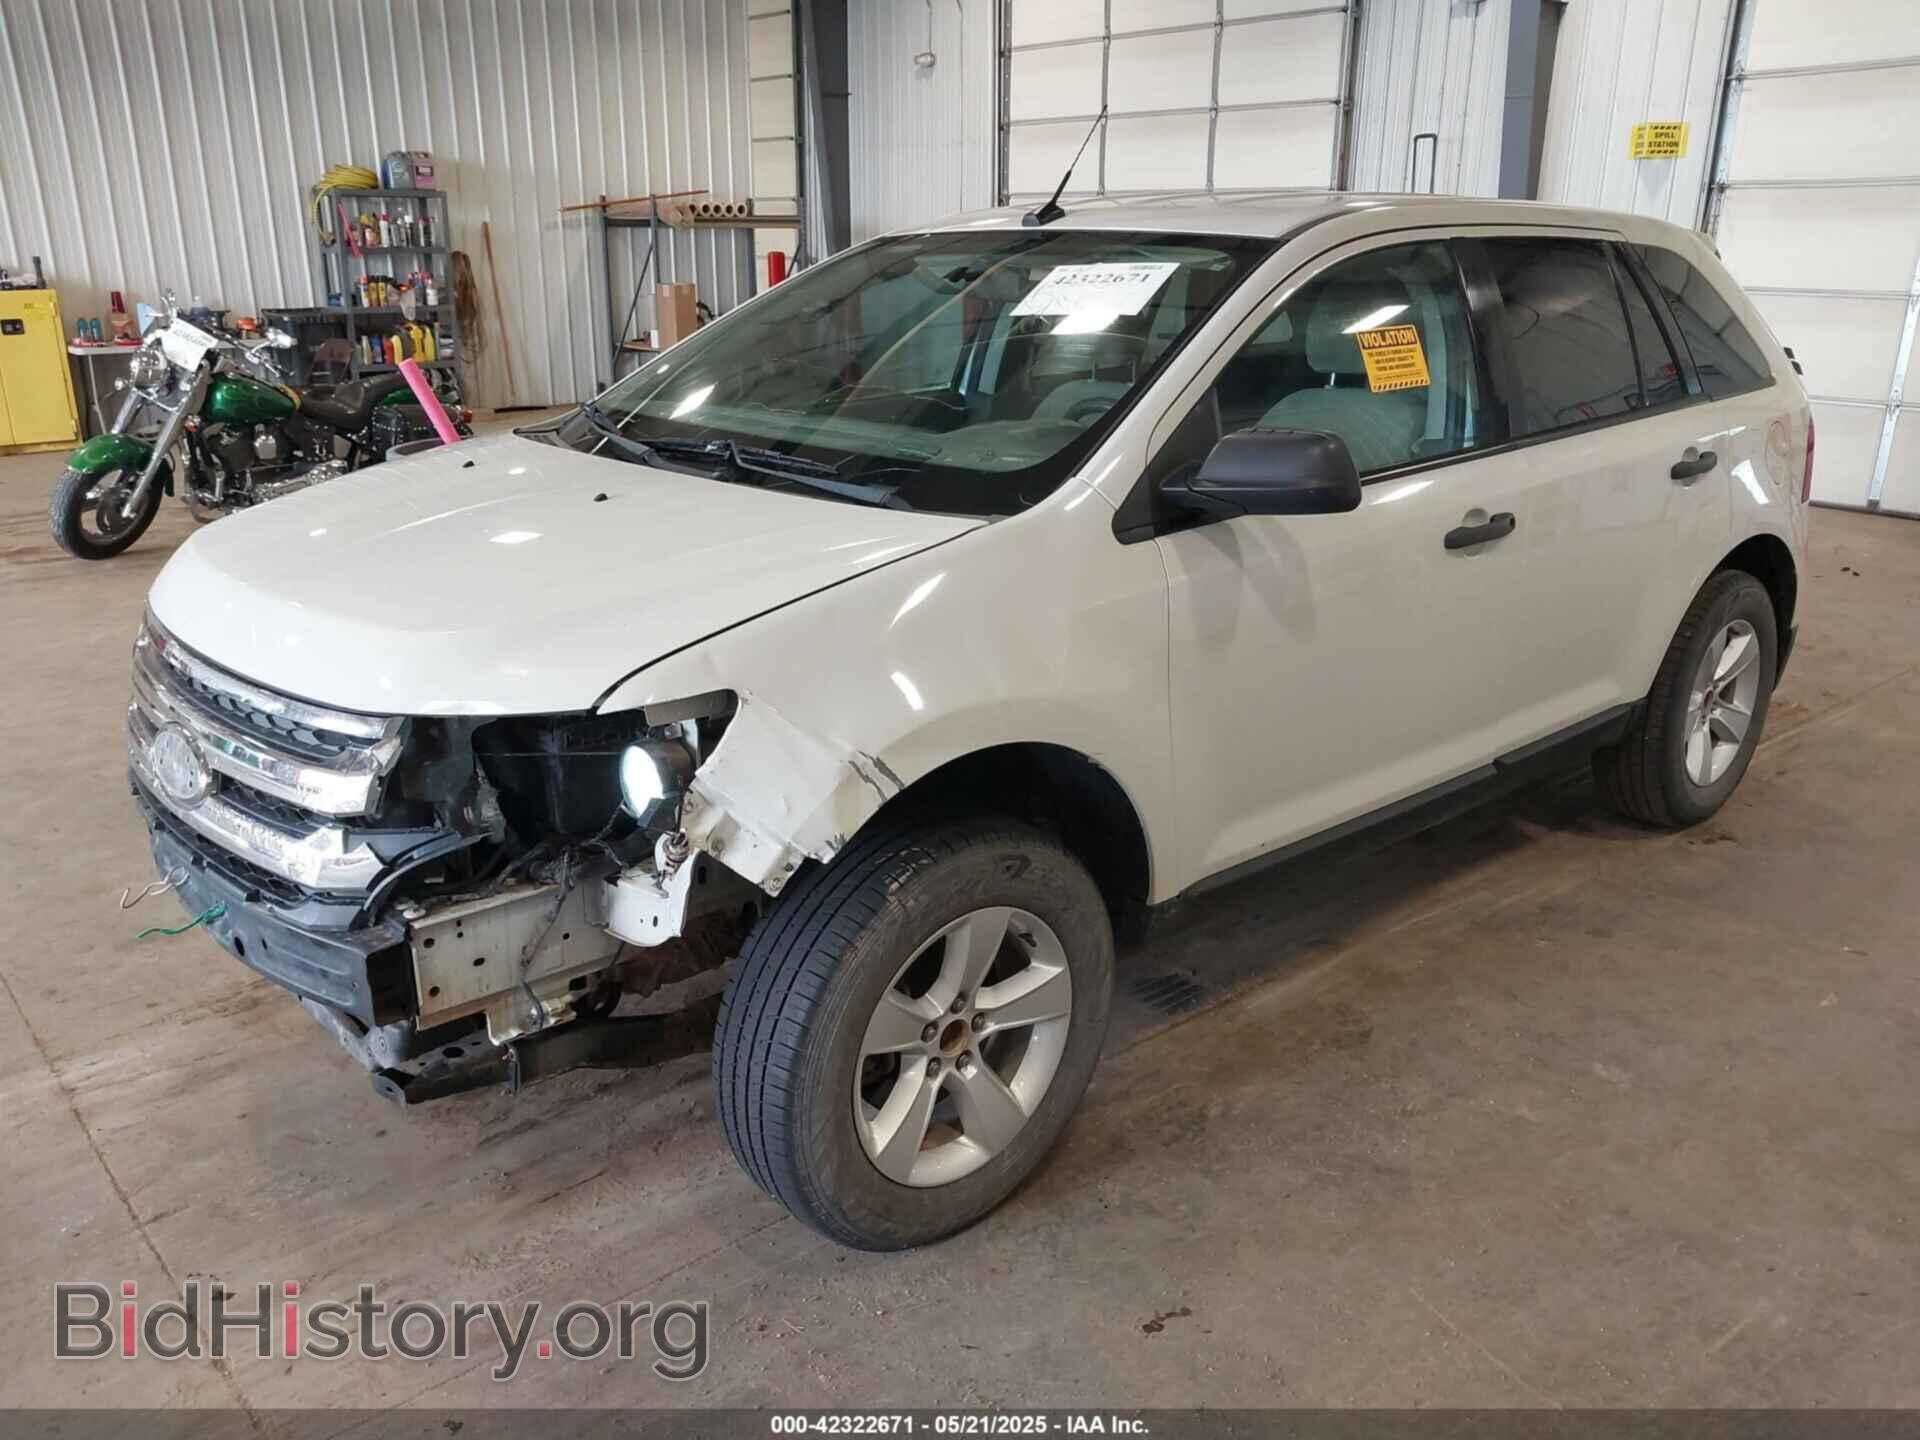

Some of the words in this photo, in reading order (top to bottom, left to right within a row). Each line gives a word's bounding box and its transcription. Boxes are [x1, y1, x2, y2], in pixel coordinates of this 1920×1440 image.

[1654, 131, 1675, 139] SPILL
[1055, 273, 1151, 285] 42322671
[1361, 329, 1416, 348] VIOLATION
